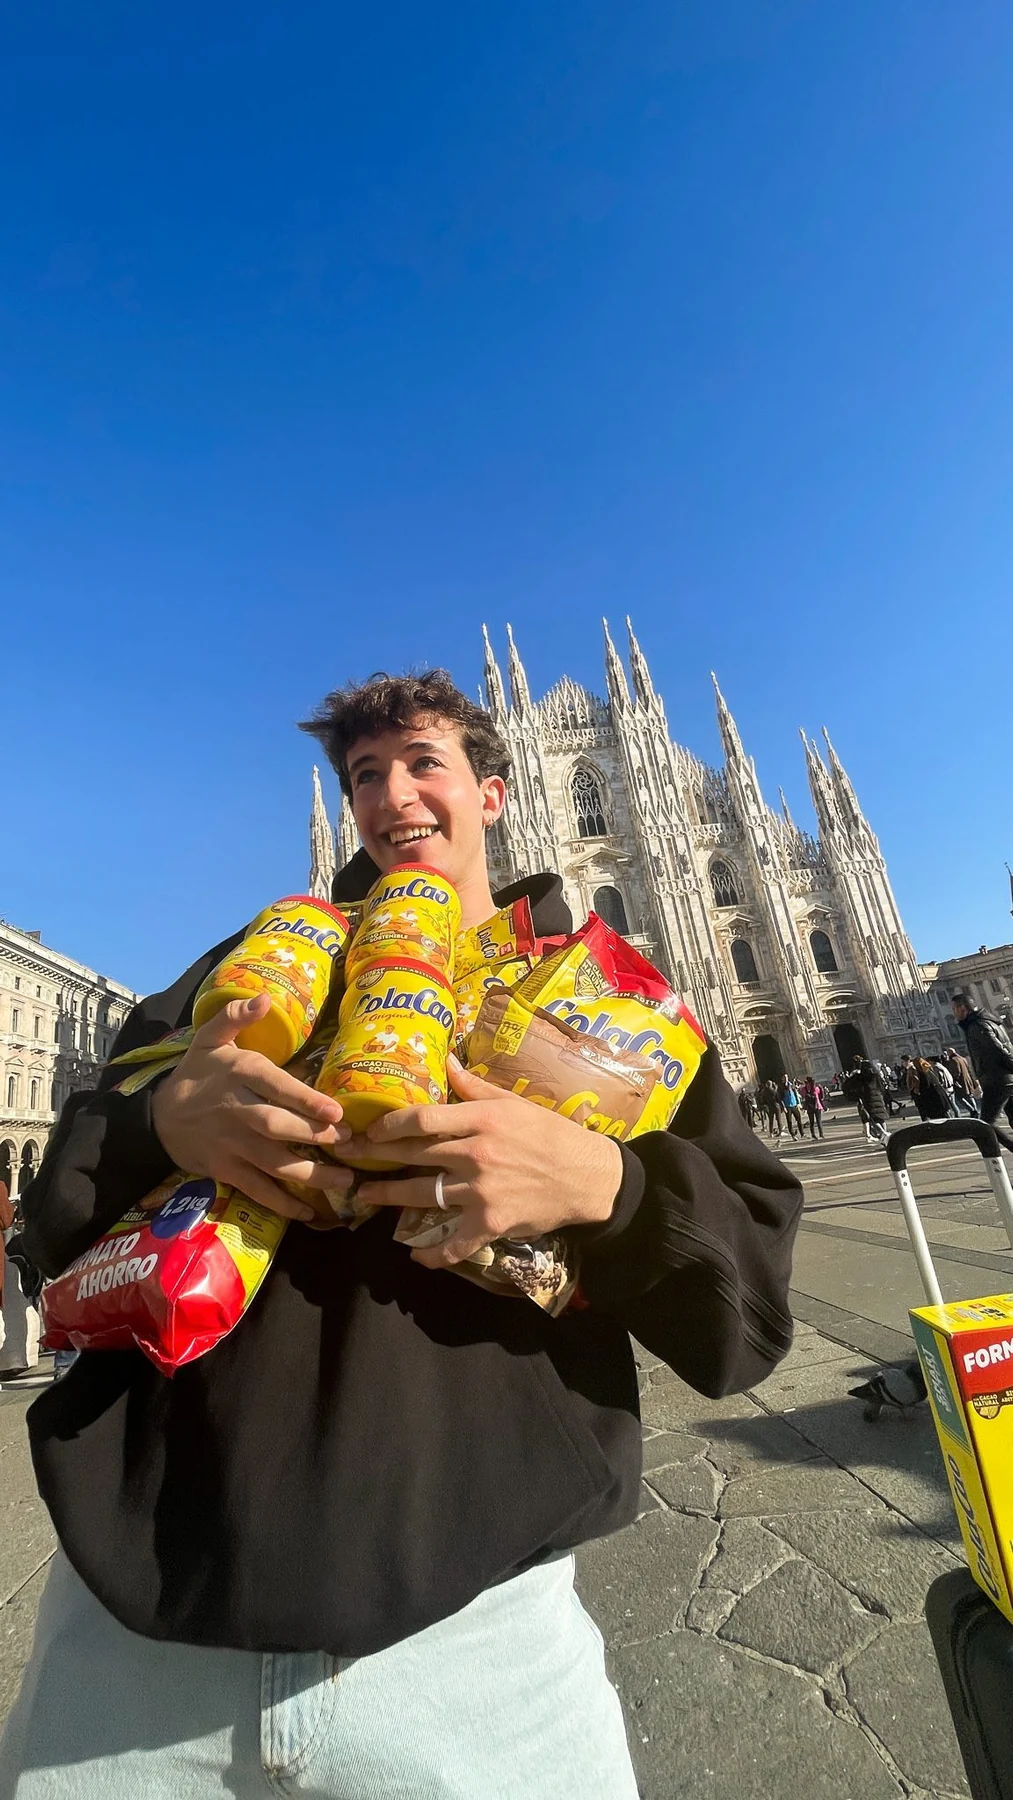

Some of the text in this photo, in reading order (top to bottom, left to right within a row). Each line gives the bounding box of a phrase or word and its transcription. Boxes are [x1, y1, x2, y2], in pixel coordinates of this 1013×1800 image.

[370, 878, 449, 910] olaCao
[246, 964, 276, 975] CACAO
[582, 961, 603, 994] NATUR
[261, 971, 301, 998] SOSTENIBLE
[349, 988, 454, 1029] ColaCao
[369, 1011, 416, 1023] Original
[351, 1060, 382, 1069] CACAO
[368, 1066, 417, 1082] SOSTENIBLE
[160, 1196, 211, 1218] 1,2kg
[64, 1232, 141, 1278] RMATO
[76, 1253, 159, 1302] AHORRO
[973, 1399, 1000, 1407] NATURAL
